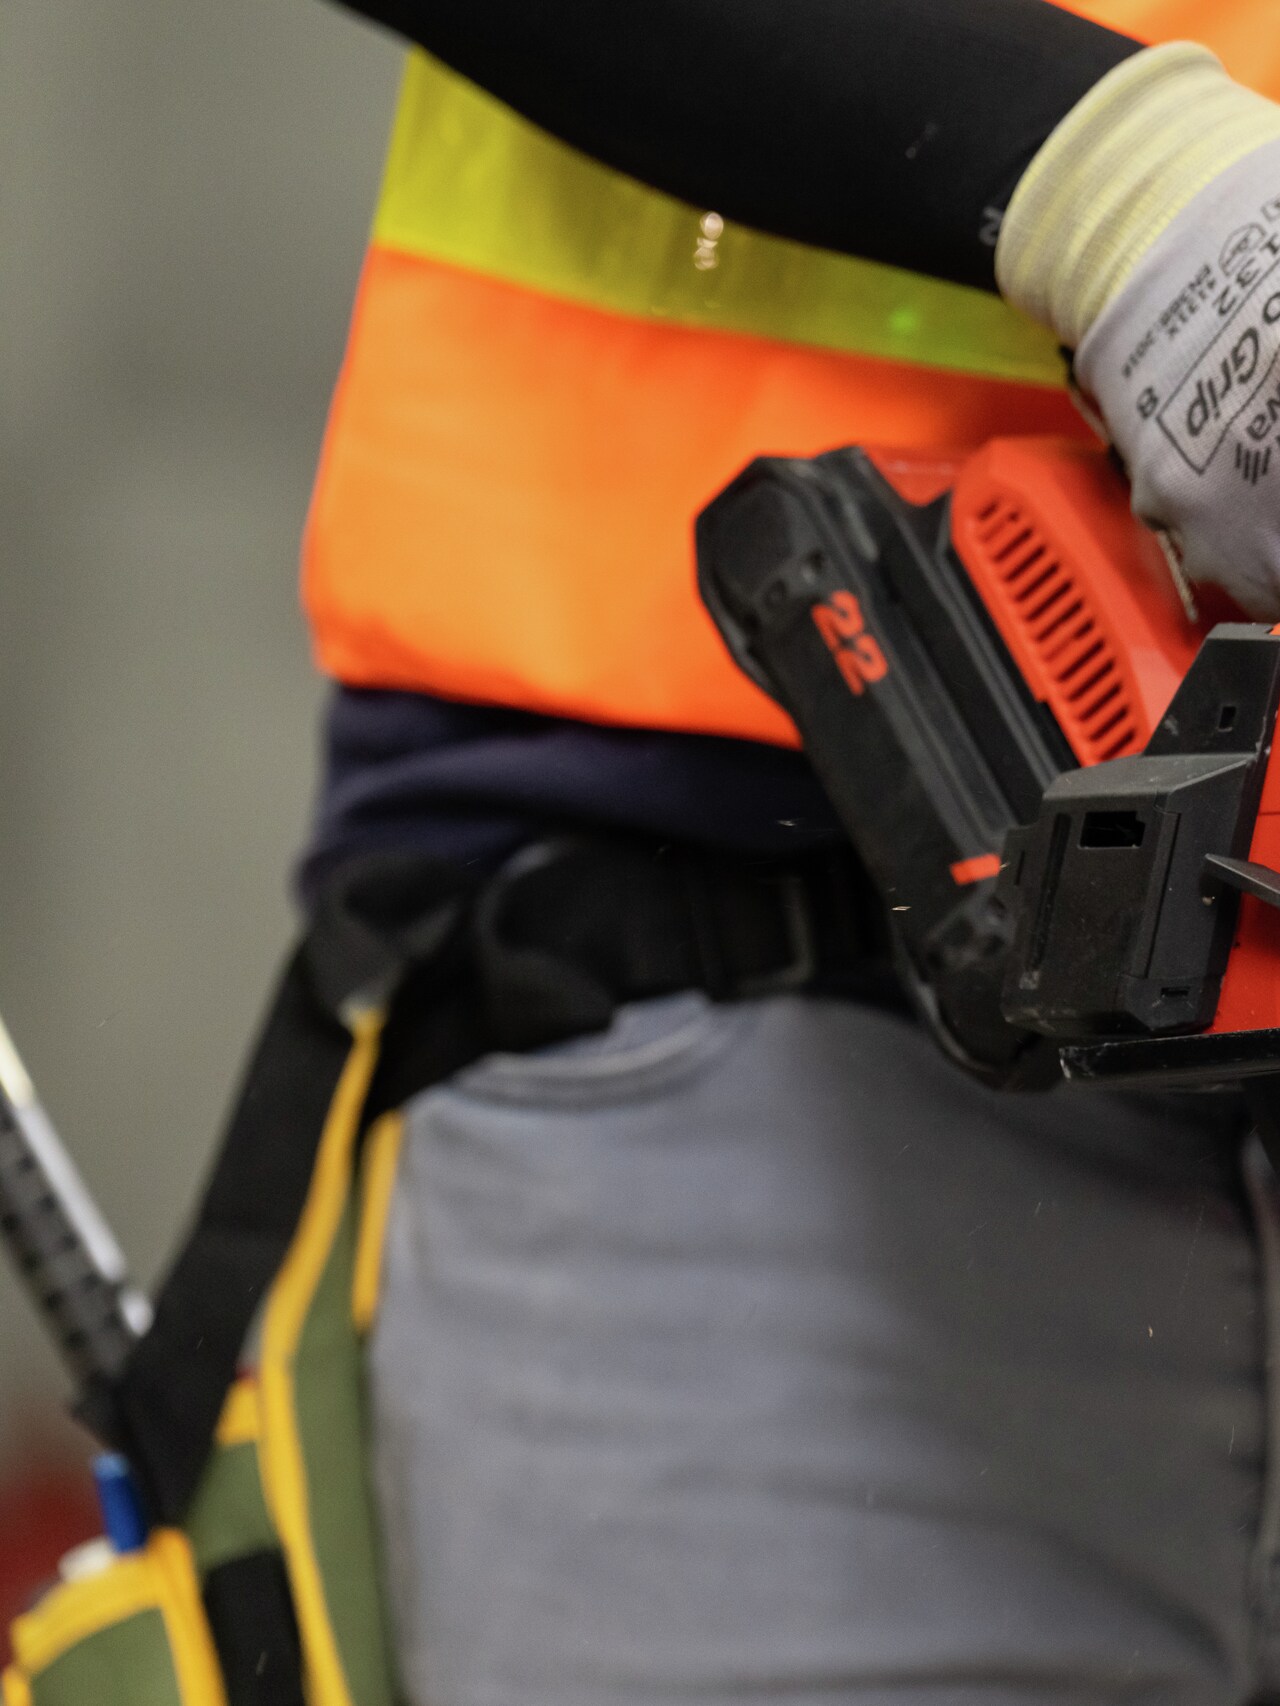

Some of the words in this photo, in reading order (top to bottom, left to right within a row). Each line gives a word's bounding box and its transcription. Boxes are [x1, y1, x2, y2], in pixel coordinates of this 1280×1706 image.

[1135, 385, 1159, 421] 8
[1186, 326, 1260, 437] Grip
[811, 589, 889, 697] 22
